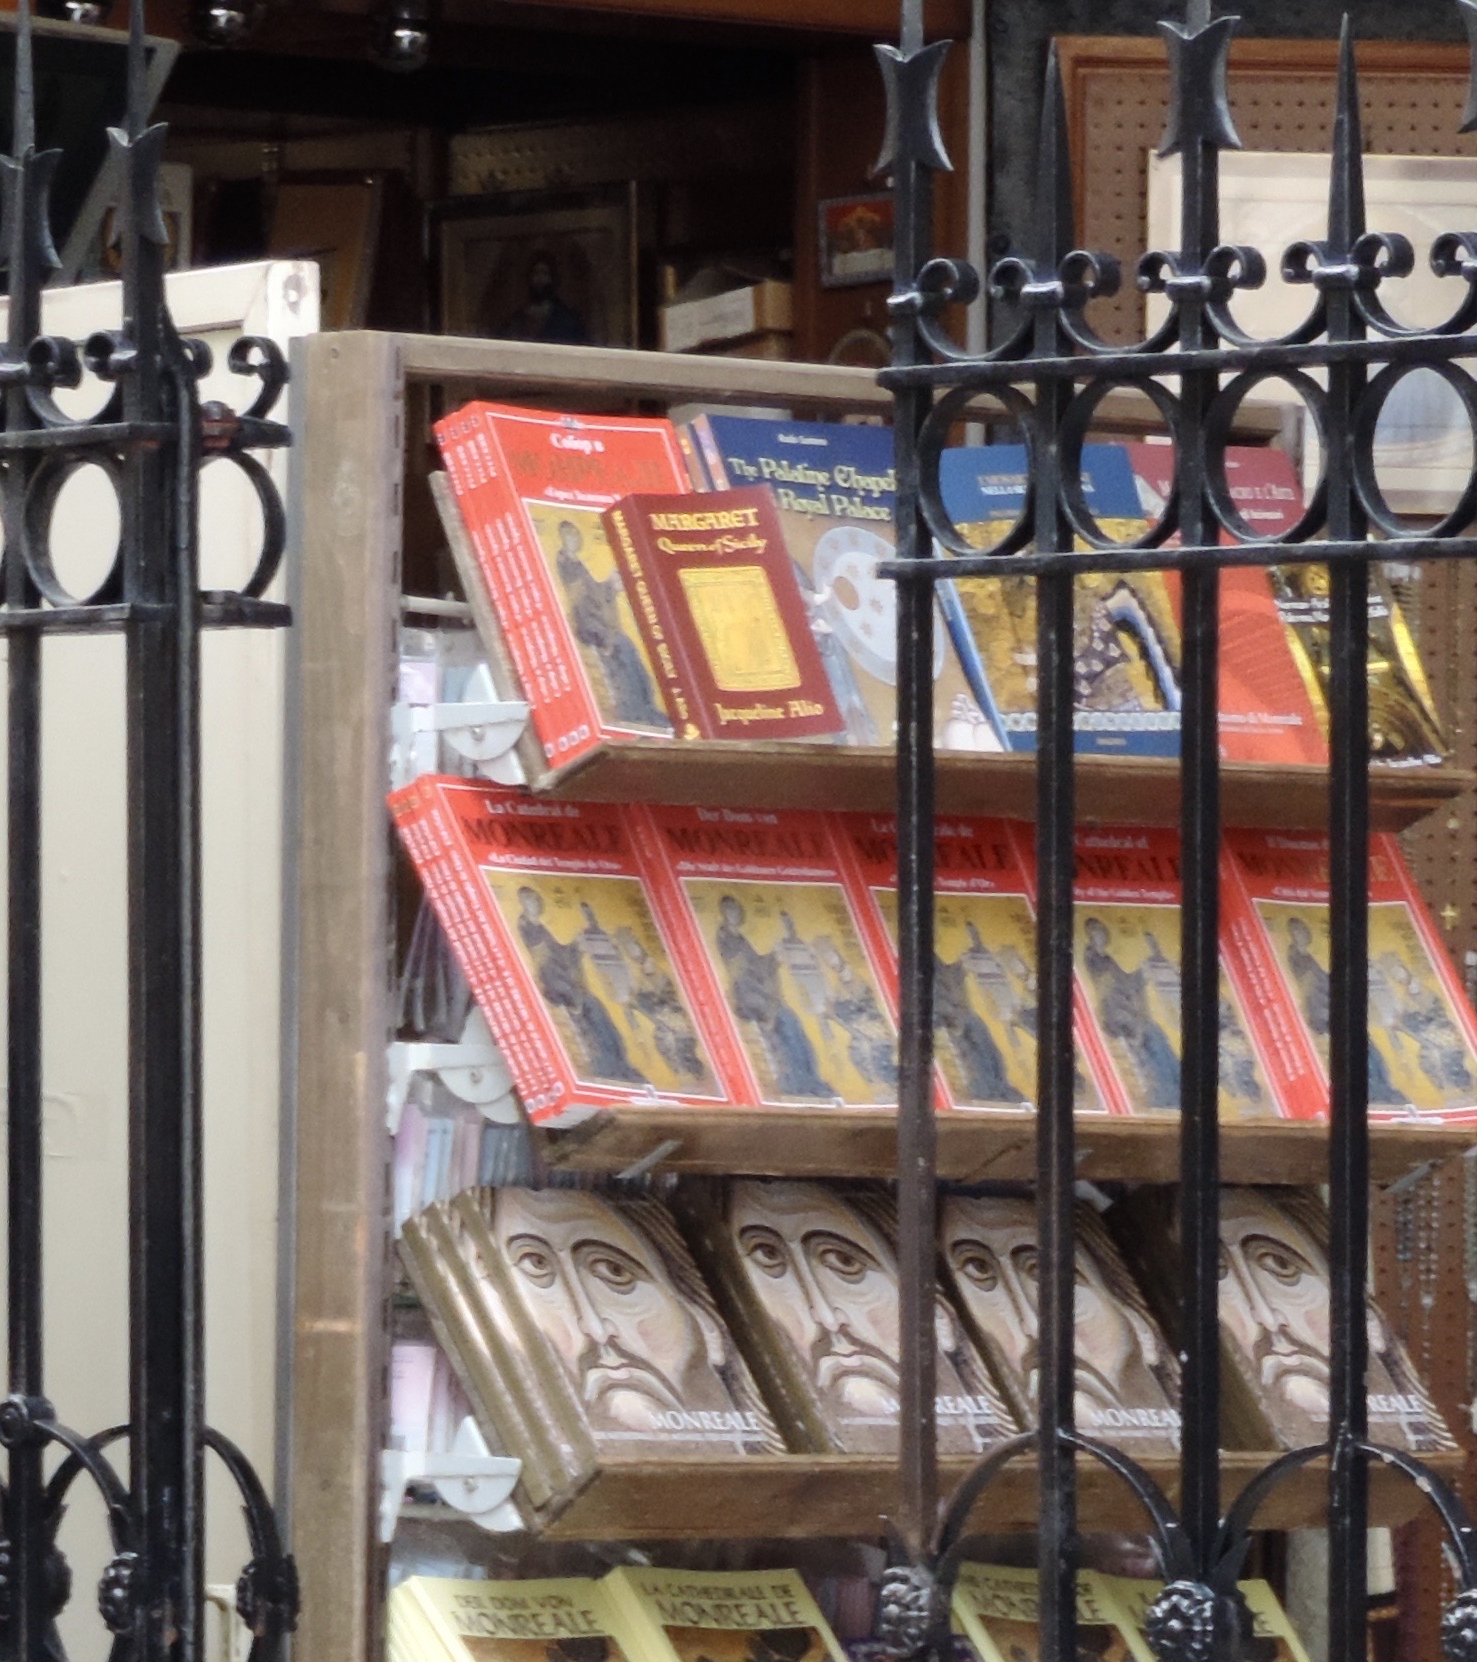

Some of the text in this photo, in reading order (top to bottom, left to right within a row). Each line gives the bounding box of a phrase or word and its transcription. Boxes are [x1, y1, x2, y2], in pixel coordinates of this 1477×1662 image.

[727, 457, 897, 498] The Palatine Chapel
[777, 488, 892, 521] Royal Palace
[649, 507, 760, 531] MARGARET
[656, 536, 707, 555] Queen
[721, 532, 768, 555] Sicily
[882, 1395, 992, 1415] MREALE
[648, 1409, 761, 1431] MONREALE
[450, 1608, 601, 1637] MONREALE
[654, 1600, 807, 1628] MONREALE
